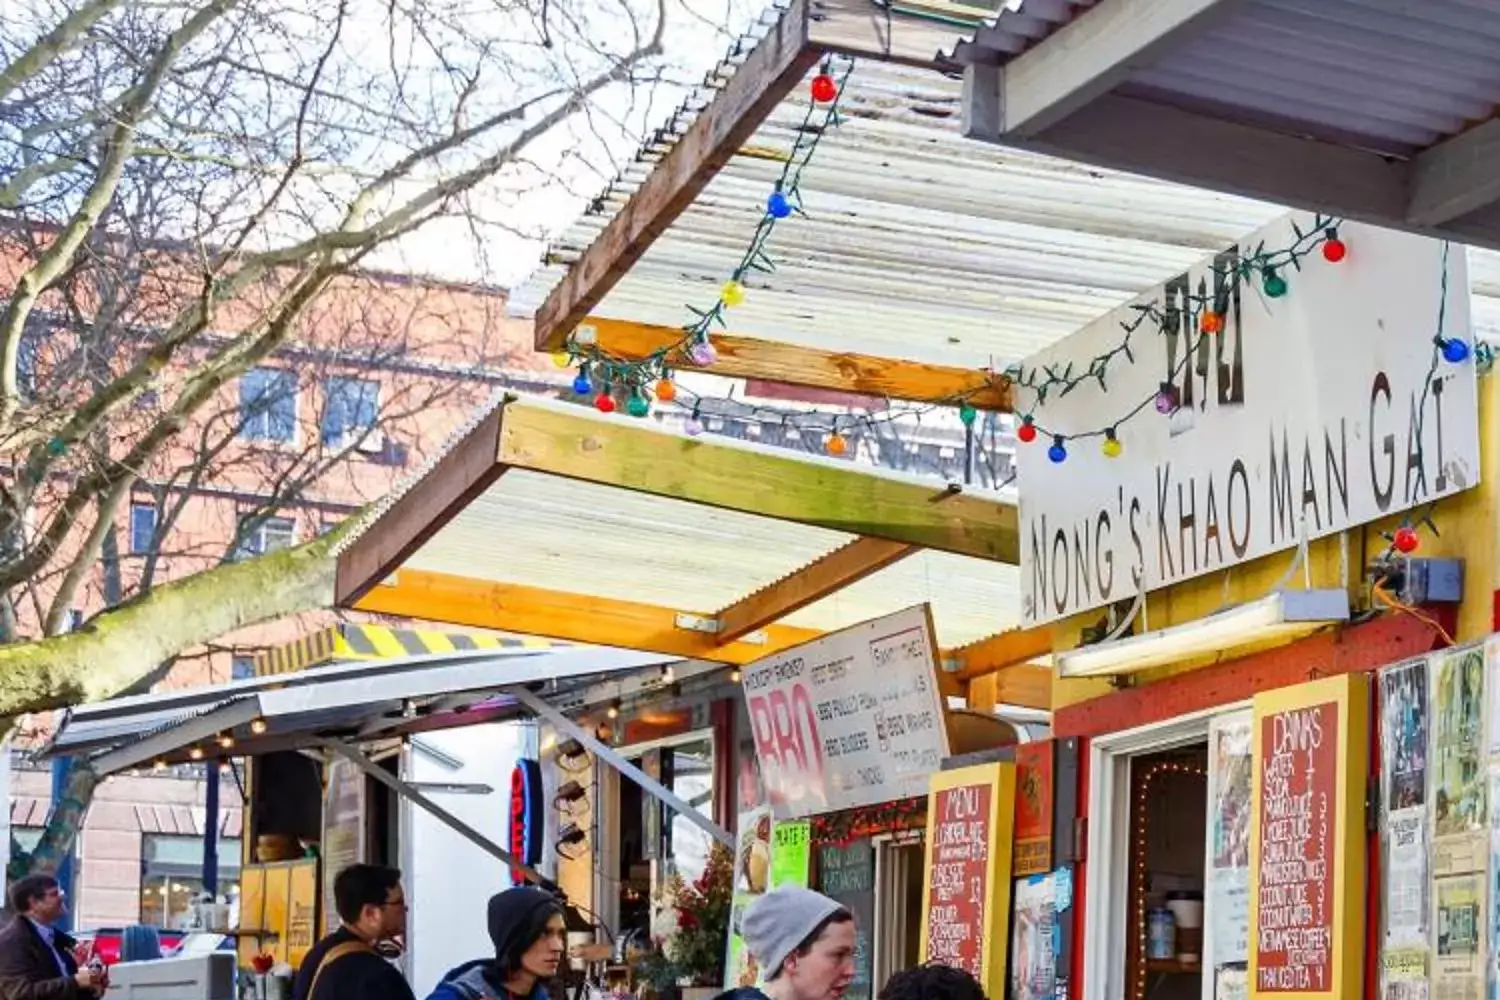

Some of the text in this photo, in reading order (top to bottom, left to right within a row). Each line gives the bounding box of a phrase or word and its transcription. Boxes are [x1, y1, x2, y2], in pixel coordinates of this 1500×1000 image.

[1155, 458, 1251, 581] KHAO
[1268, 413, 1350, 546] MAN
[1368, 371, 1449, 510] GAI
